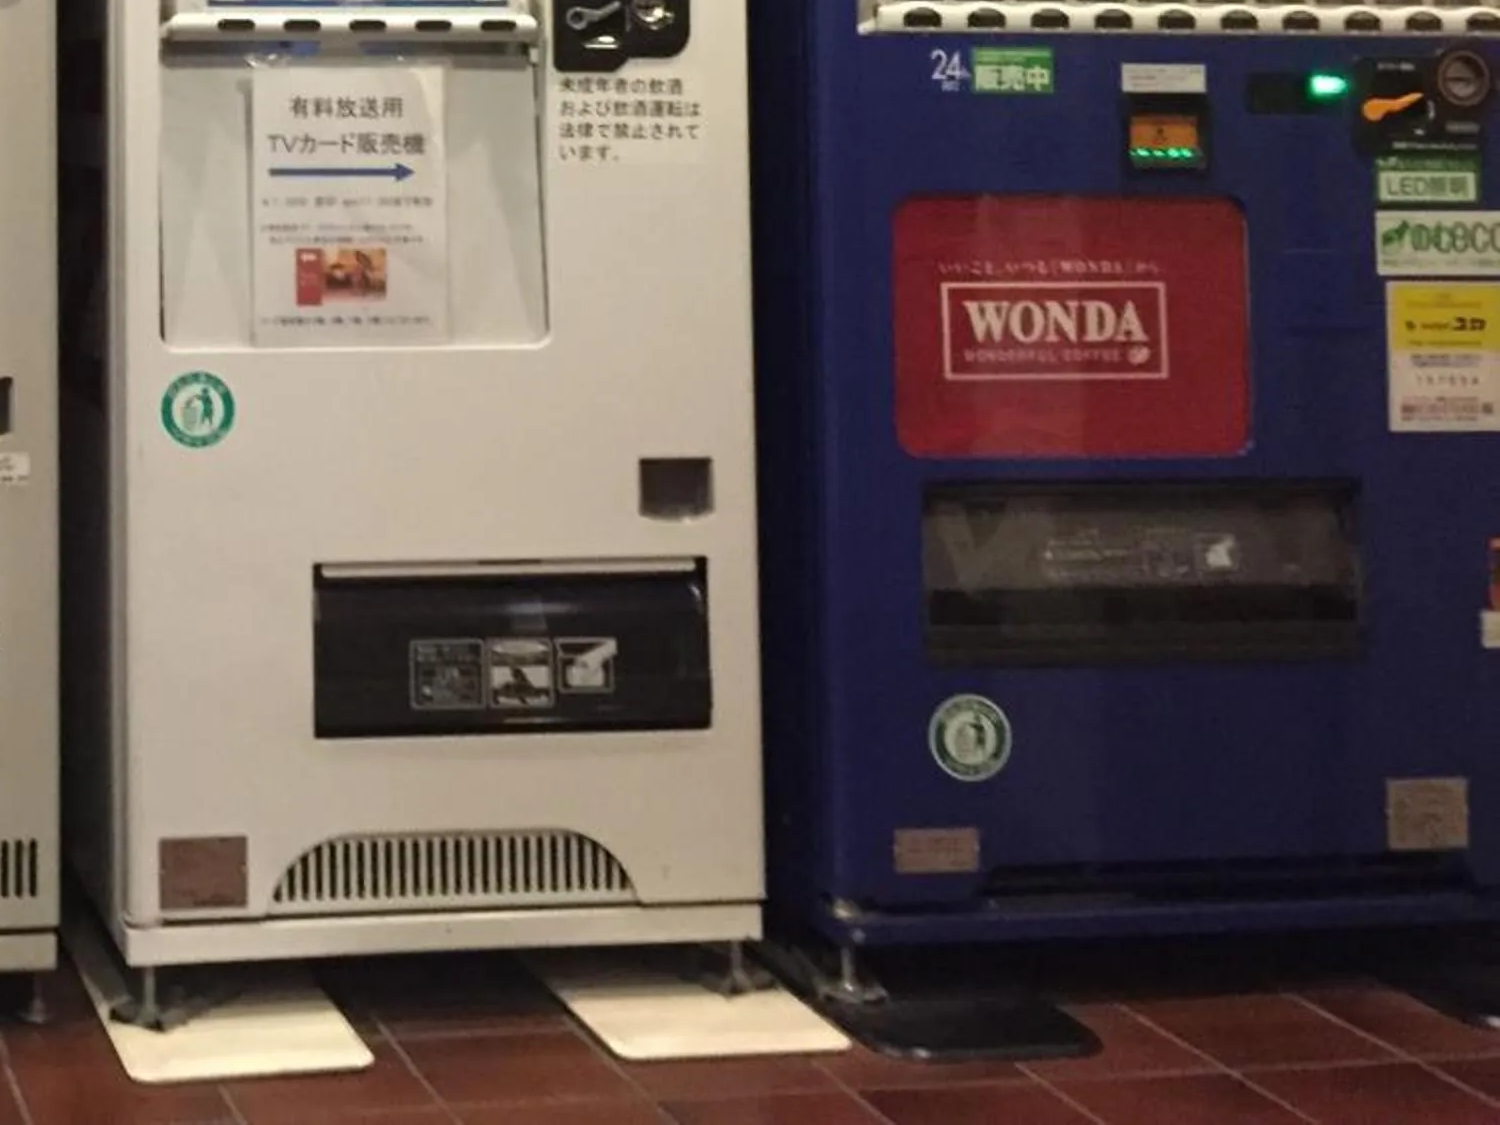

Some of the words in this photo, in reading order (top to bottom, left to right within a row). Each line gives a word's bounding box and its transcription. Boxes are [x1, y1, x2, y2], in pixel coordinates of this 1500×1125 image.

[931, 48, 966, 80] 24
[560, 78, 683, 95] 未成年者の飲酒
[290, 96, 404, 119] 有料放送用
[560, 100, 701, 117] および飲酒運転は
[560, 123, 700, 140] 法律で禁止されて
[267, 133, 426, 156] TVカード販売機
[961, 300, 1150, 344] WONDA
